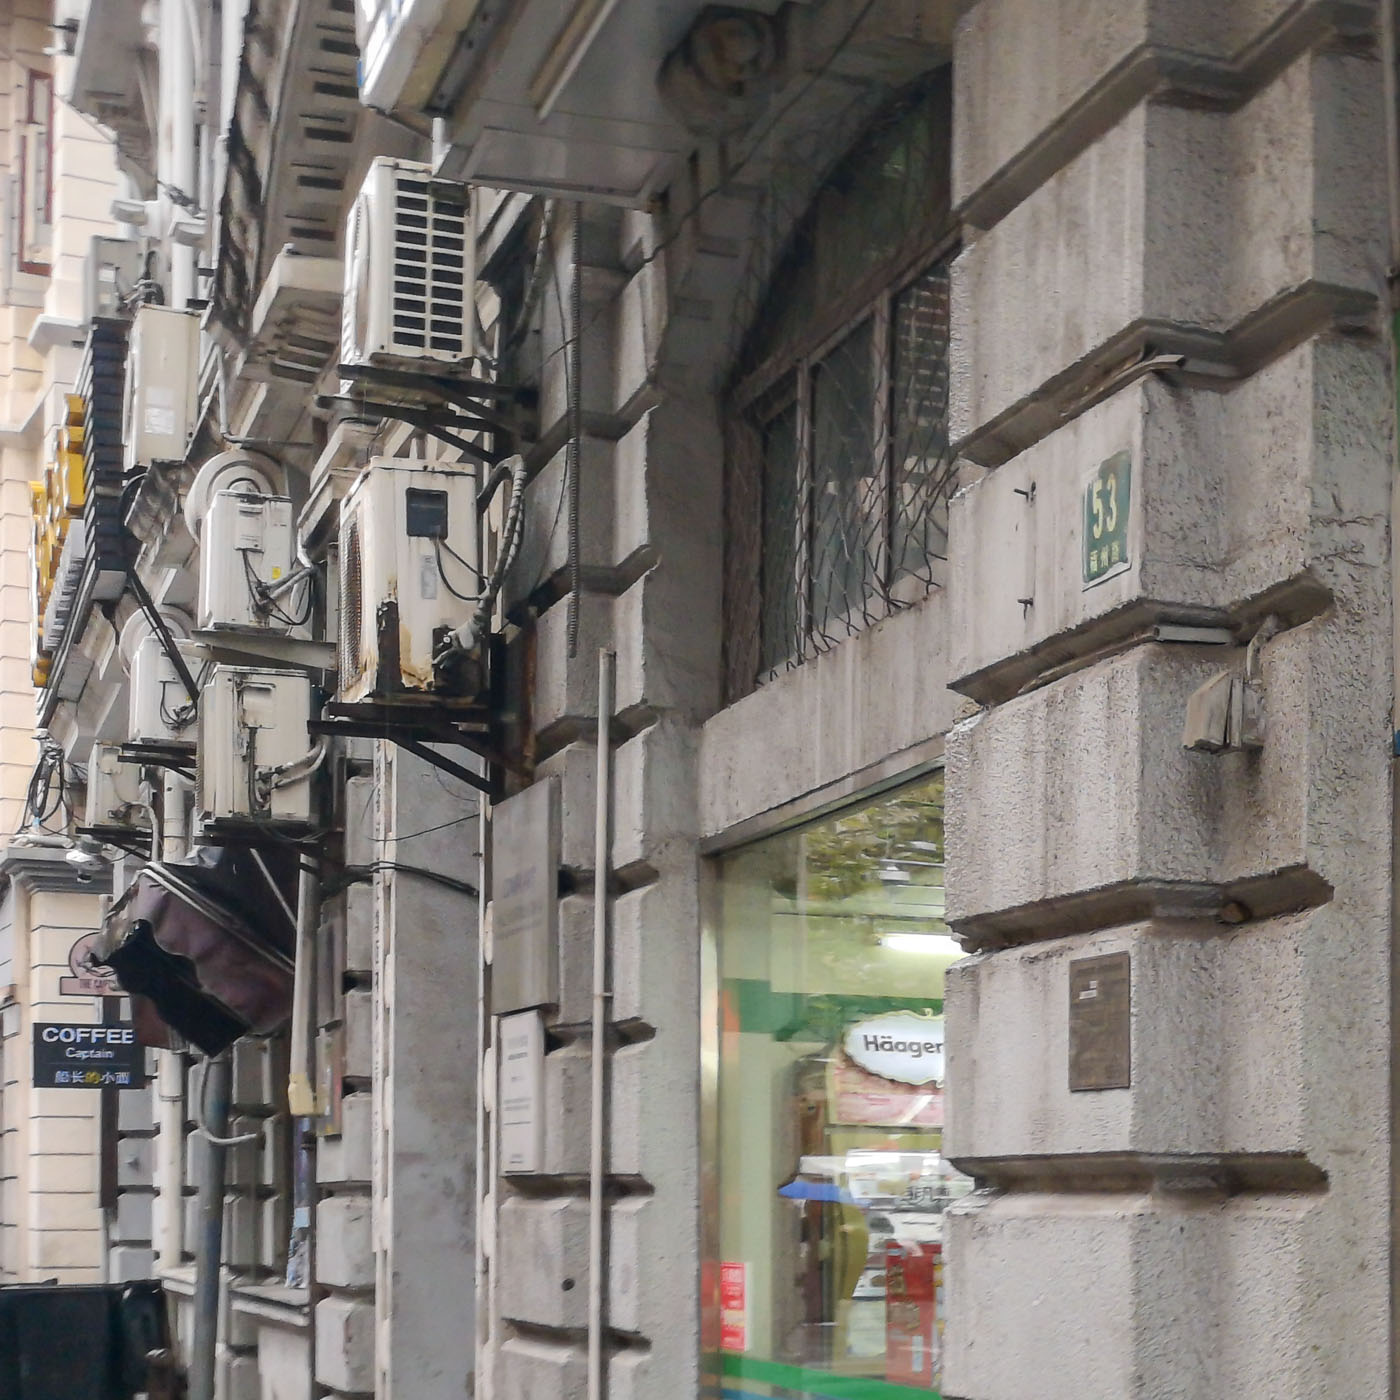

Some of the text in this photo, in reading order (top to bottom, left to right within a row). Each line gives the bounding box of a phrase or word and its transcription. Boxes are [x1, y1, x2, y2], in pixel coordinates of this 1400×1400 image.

[1092, 472, 1117, 539] 53
[42, 1027, 134, 1044] COFFEE
[65, 1047, 115, 1061] Captain
